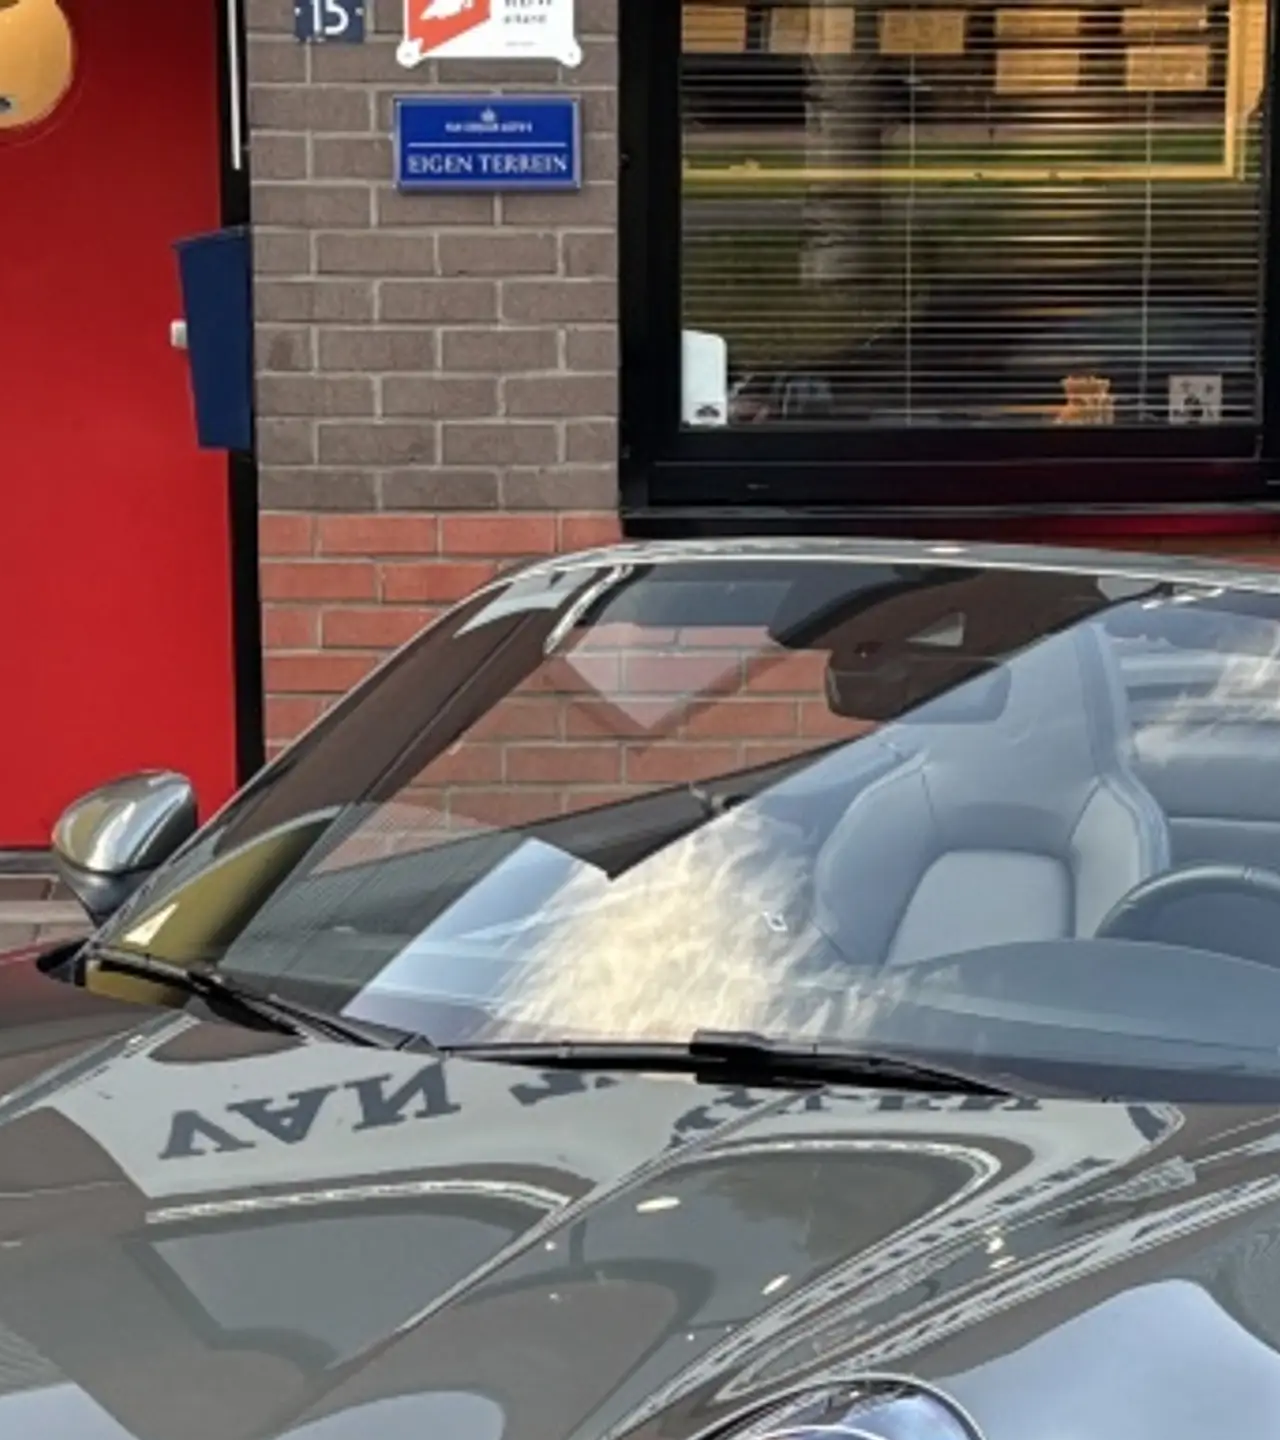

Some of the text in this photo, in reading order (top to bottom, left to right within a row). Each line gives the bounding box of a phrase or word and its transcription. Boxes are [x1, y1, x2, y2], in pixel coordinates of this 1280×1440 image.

[310, 0, 349, 35] 15
[407, 154, 567, 173] EIGEN TERREIN
